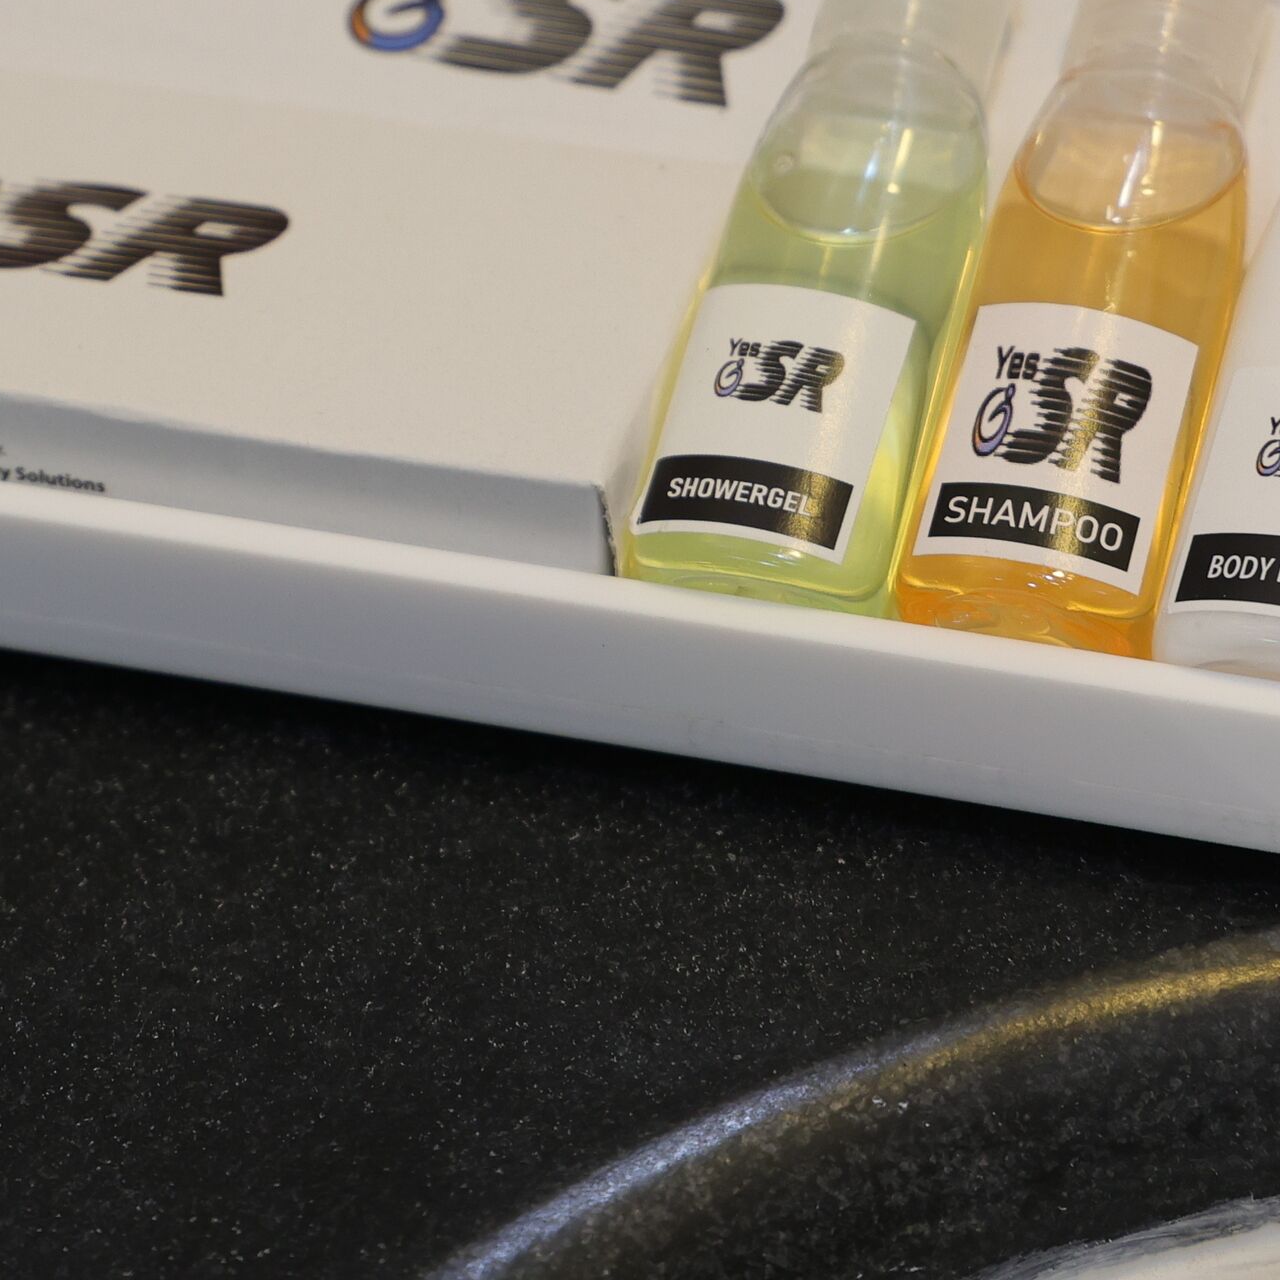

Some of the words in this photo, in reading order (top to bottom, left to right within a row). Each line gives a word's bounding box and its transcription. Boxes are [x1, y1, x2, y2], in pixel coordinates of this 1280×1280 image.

[728, 336, 762, 358] Yes
[994, 344, 1042, 381] Yes
[732, 338, 846, 414] SR
[993, 346, 1153, 484] SR
[15, 465, 106, 493] Solutions
[666, 476, 813, 517] SHOWERGEL
[943, 494, 1125, 553] SHAMPOO
[1206, 553, 1276, 581] BODY
